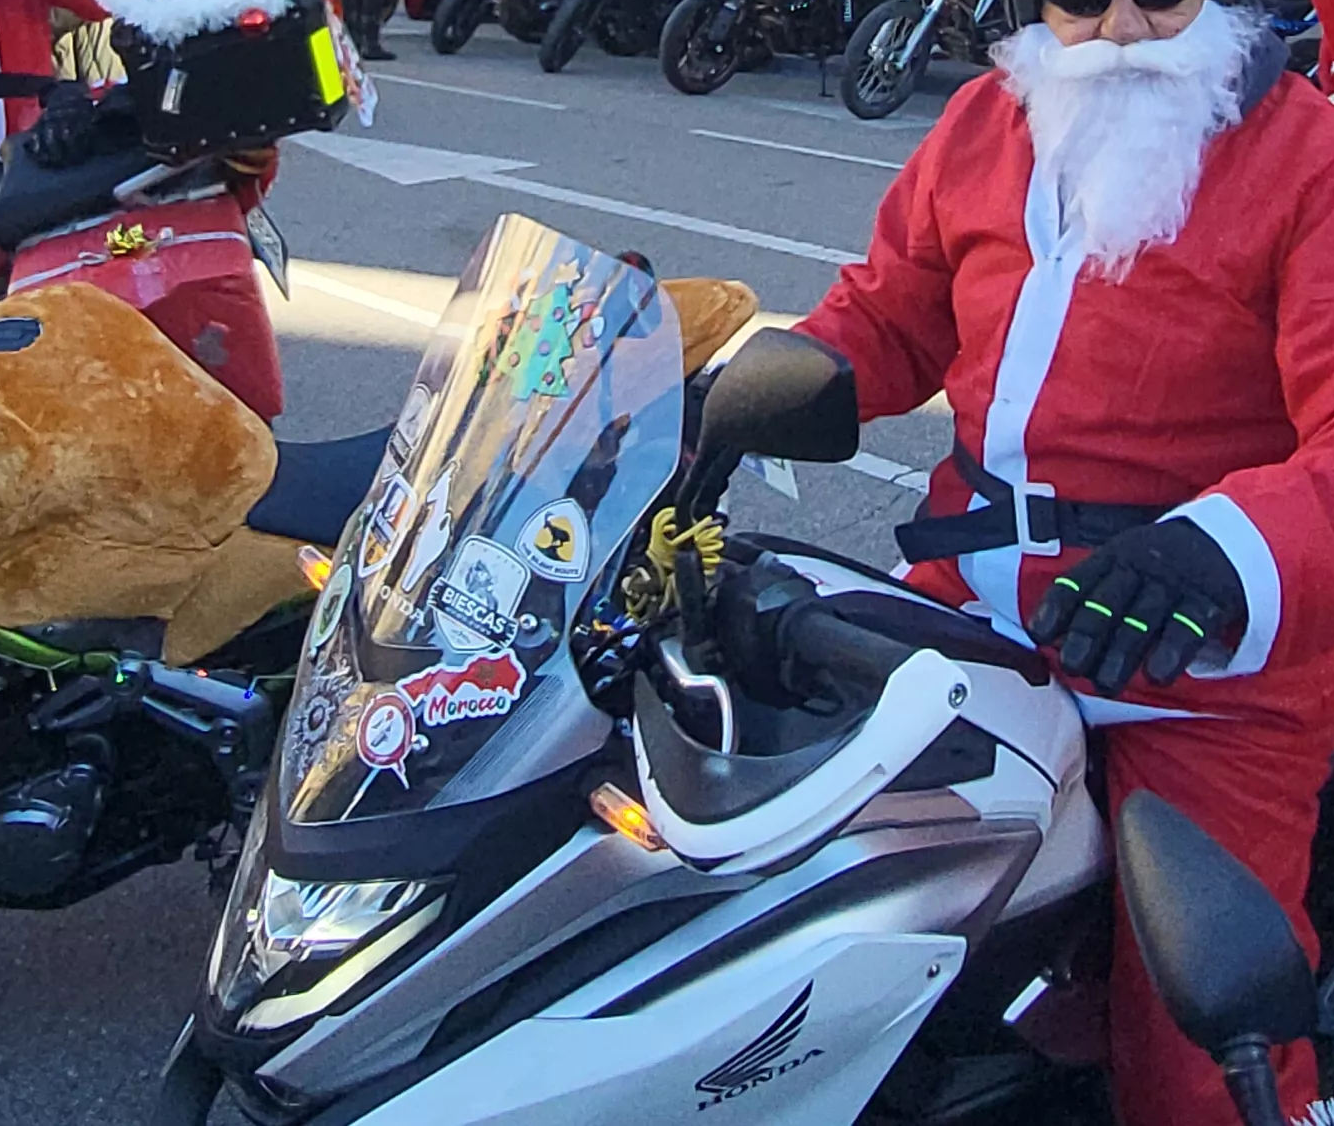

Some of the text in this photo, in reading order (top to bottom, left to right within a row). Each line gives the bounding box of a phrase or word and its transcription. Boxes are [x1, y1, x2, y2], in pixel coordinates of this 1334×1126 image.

[441, 587, 507, 634] BIESCAS
[428, 694, 507, 722] Morocco
[695, 1048, 826, 1113] HONDA
